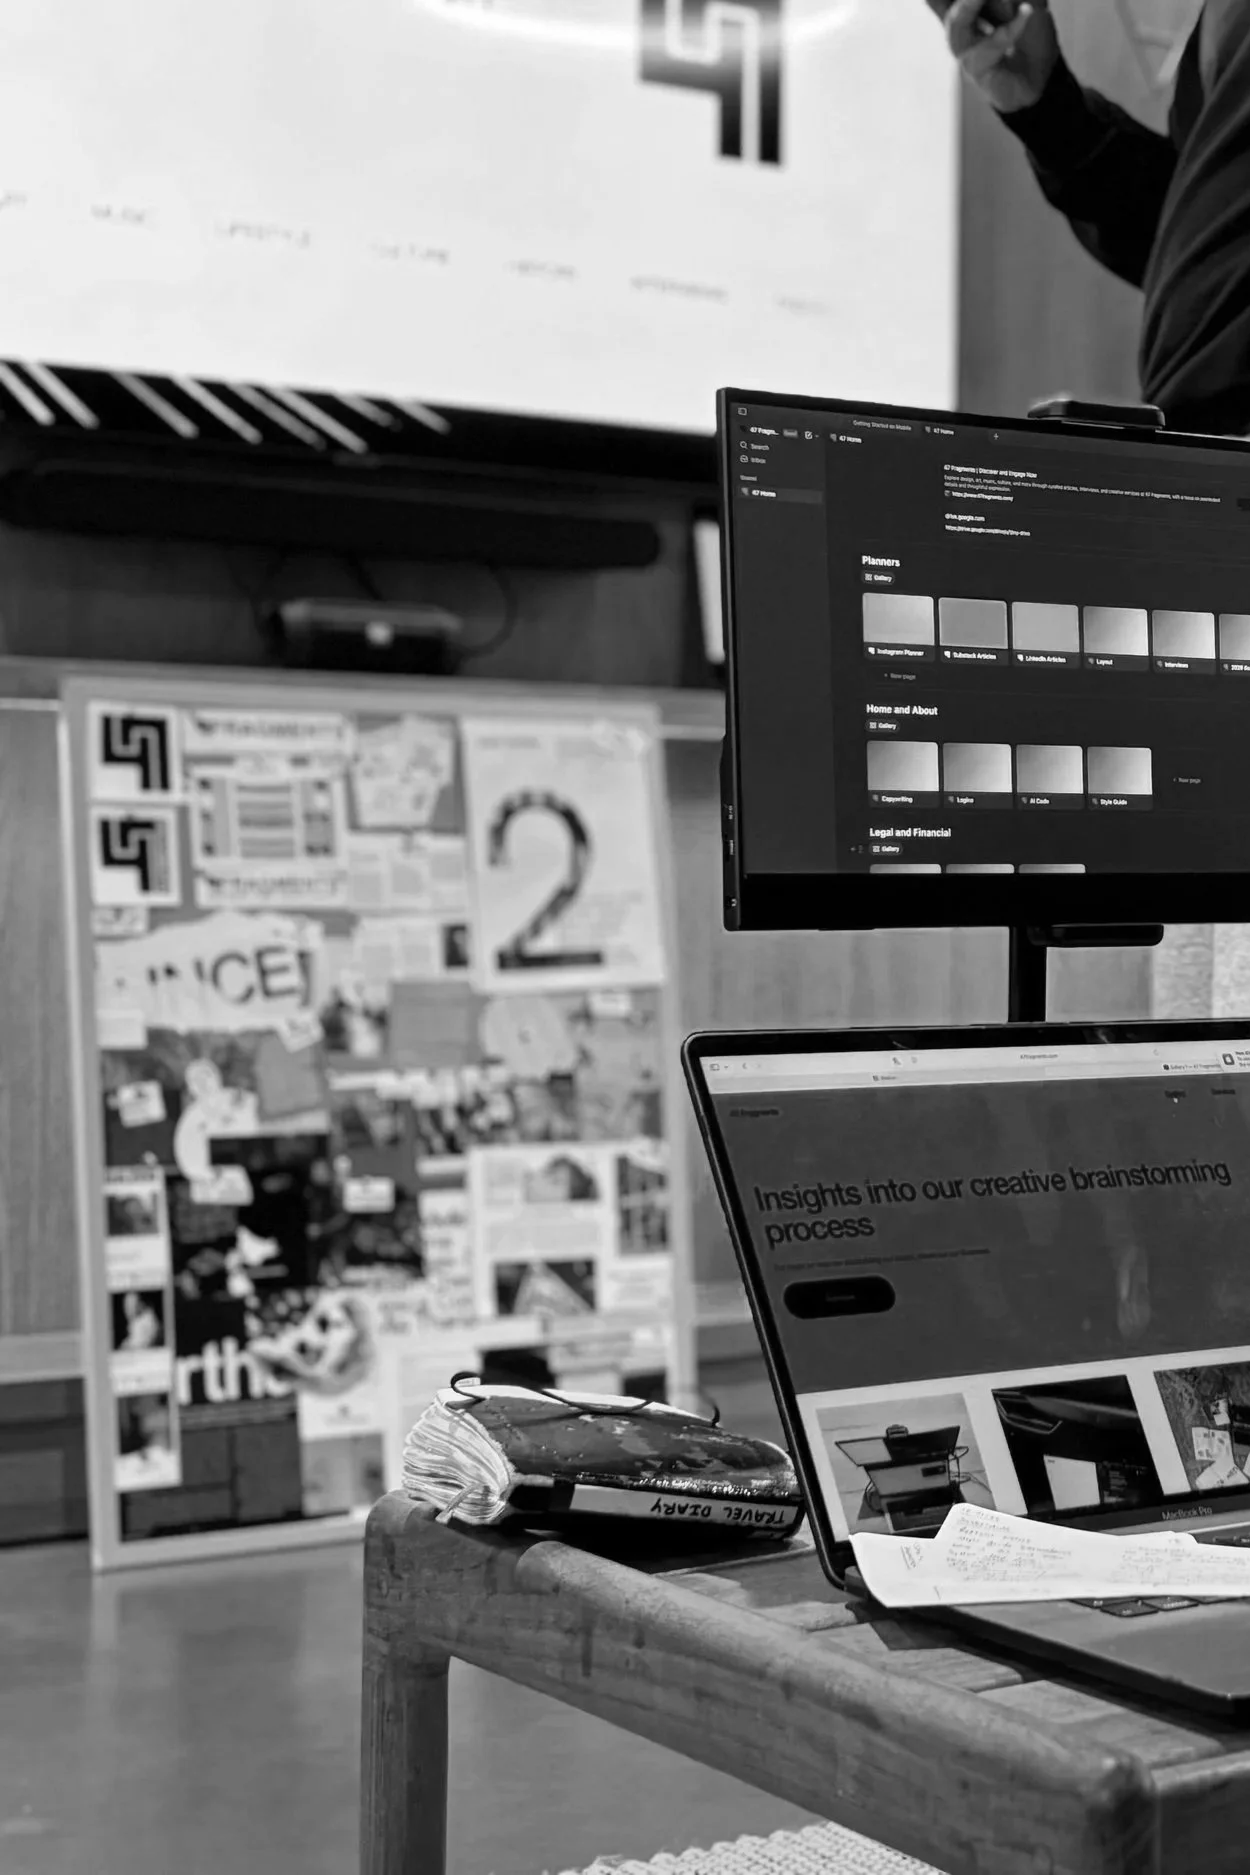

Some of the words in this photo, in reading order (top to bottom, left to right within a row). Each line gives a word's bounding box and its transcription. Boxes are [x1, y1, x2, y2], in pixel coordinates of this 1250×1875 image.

[760, 490, 776, 498] Home
[862, 555, 900, 567] Planners
[874, 574, 892, 583] Gallery
[877, 648, 904, 656] Instagram
[953, 651, 976, 659] Substack
[977, 652, 997, 660] Articles
[1026, 655, 1046, 663] LinkedIn
[1096, 658, 1113, 666] Layout
[1164, 661, 1188, 669] Interviews
[866, 704, 892, 714] Home
[894, 705, 910, 714] and
[912, 705, 938, 716] About
[878, 722, 897, 730] Gallery
[1100, 798, 1112, 806] Style
[1113, 798, 1128, 806] Guide
[870, 828, 893, 838] Legal
[895, 828, 911, 837] and
[913, 828, 952, 838] Financial
[881, 845, 900, 853] Gallery
[489, 790, 604, 969] 2
[754, 1182, 862, 1214] Insights
[866, 1178, 917, 1204] into
[921, 1178, 963, 1200] our
[969, 1169, 1066, 1197] creative
[1068, 1158, 1232, 1192] brainstorming
[764, 1216, 876, 1250] process
[650, 1498, 712, 1518] DIARY
[723, 1506, 784, 1525] TRAVEL
[1162, 1508, 1198, 1520] MacBook
[1198, 1506, 1212, 1517] Pro
